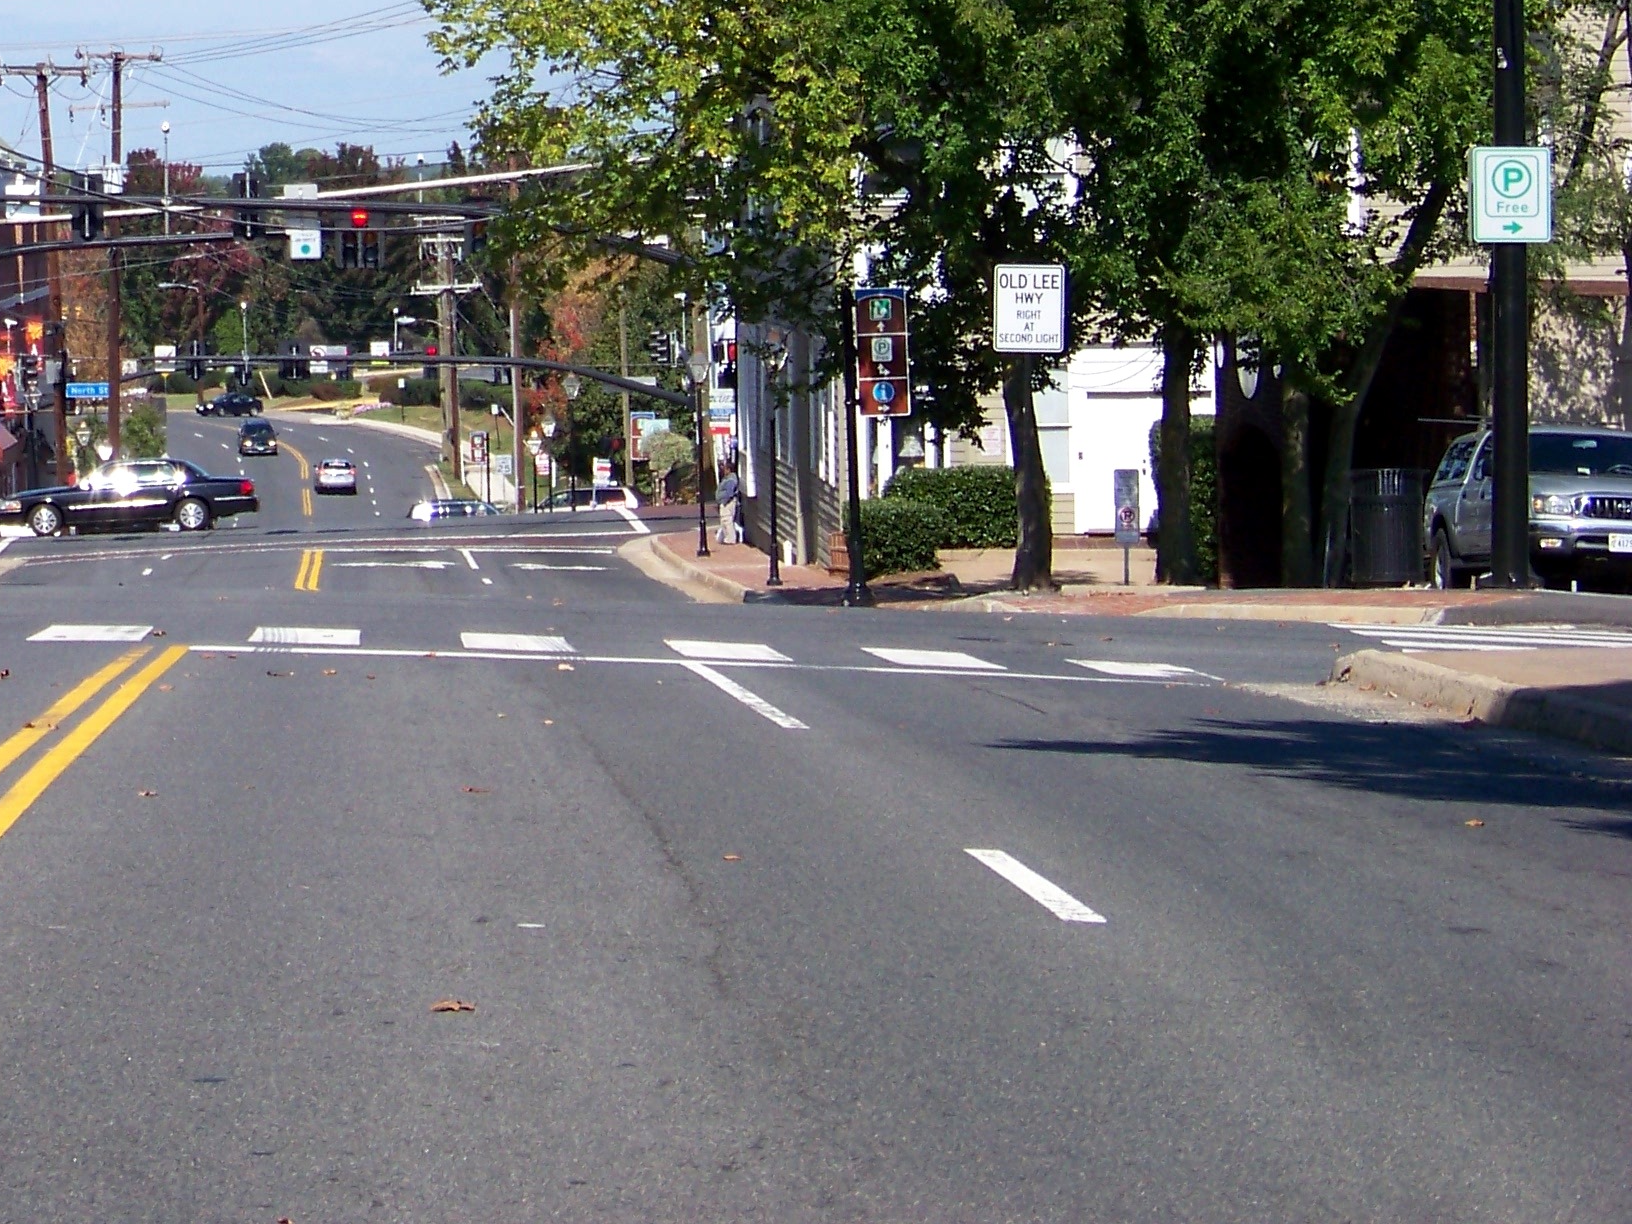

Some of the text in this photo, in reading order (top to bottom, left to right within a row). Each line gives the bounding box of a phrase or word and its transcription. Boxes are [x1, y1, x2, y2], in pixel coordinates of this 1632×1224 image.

[1503, 167, 1524, 192] P
[1496, 201, 1529, 213] Free
[999, 273, 1060, 290] OLD LEE
[1015, 293, 1044, 305] HWY
[1016, 310, 1042, 320] RIGHT
[1023, 322, 1034, 332] AT
[999, 333, 1059, 343] SECOND LIGHT
[98, 386, 109, 394] St
[497, 464, 511, 473] 25
